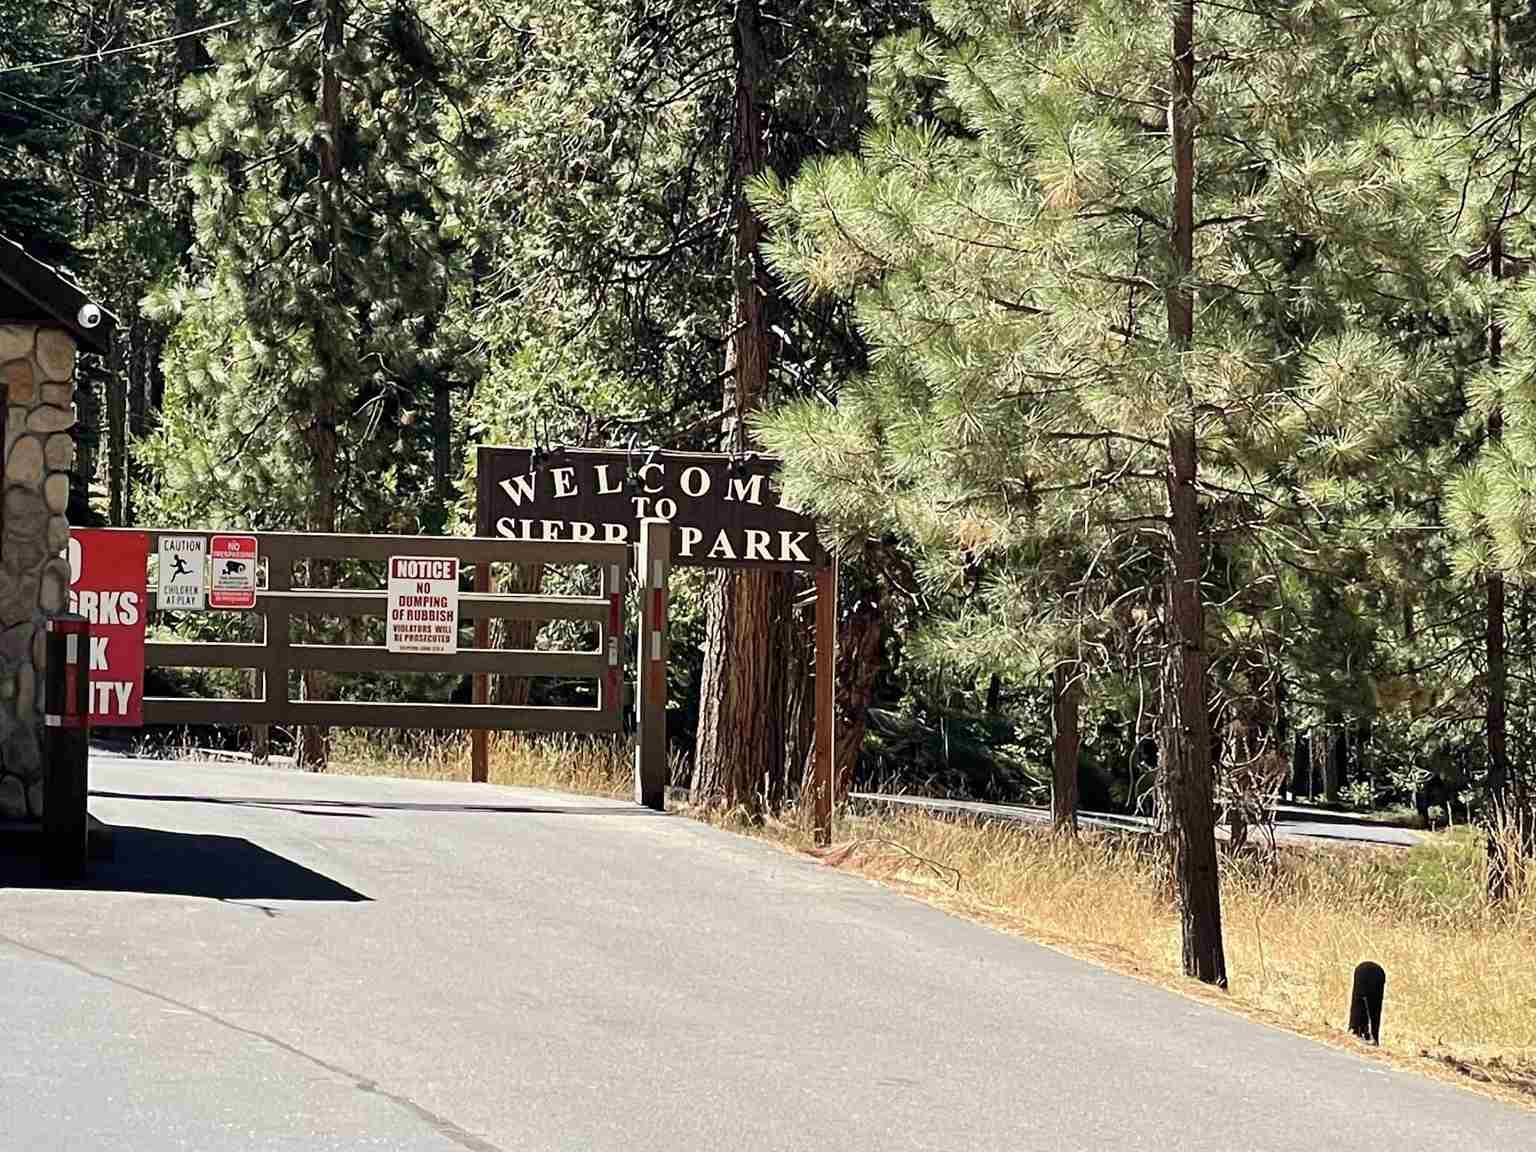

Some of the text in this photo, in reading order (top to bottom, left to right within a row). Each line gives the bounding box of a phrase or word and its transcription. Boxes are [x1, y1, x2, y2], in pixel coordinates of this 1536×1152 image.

[631, 496, 677, 519] TO
[164, 539, 202, 551] CAUTION
[679, 526, 810, 562] PARK
[397, 560, 451, 578] NOTICE
[164, 586, 199, 594] CHILDREN
[416, 582, 431, 594] NO
[166, 595, 196, 605] AT PLAY
[399, 596, 448, 607] DUMPING
[392, 609, 454, 622] OF RUBBISH
[393, 624, 452, 634] VIOLATORS WILL
[404, 634, 450, 643] PROSECUTED
